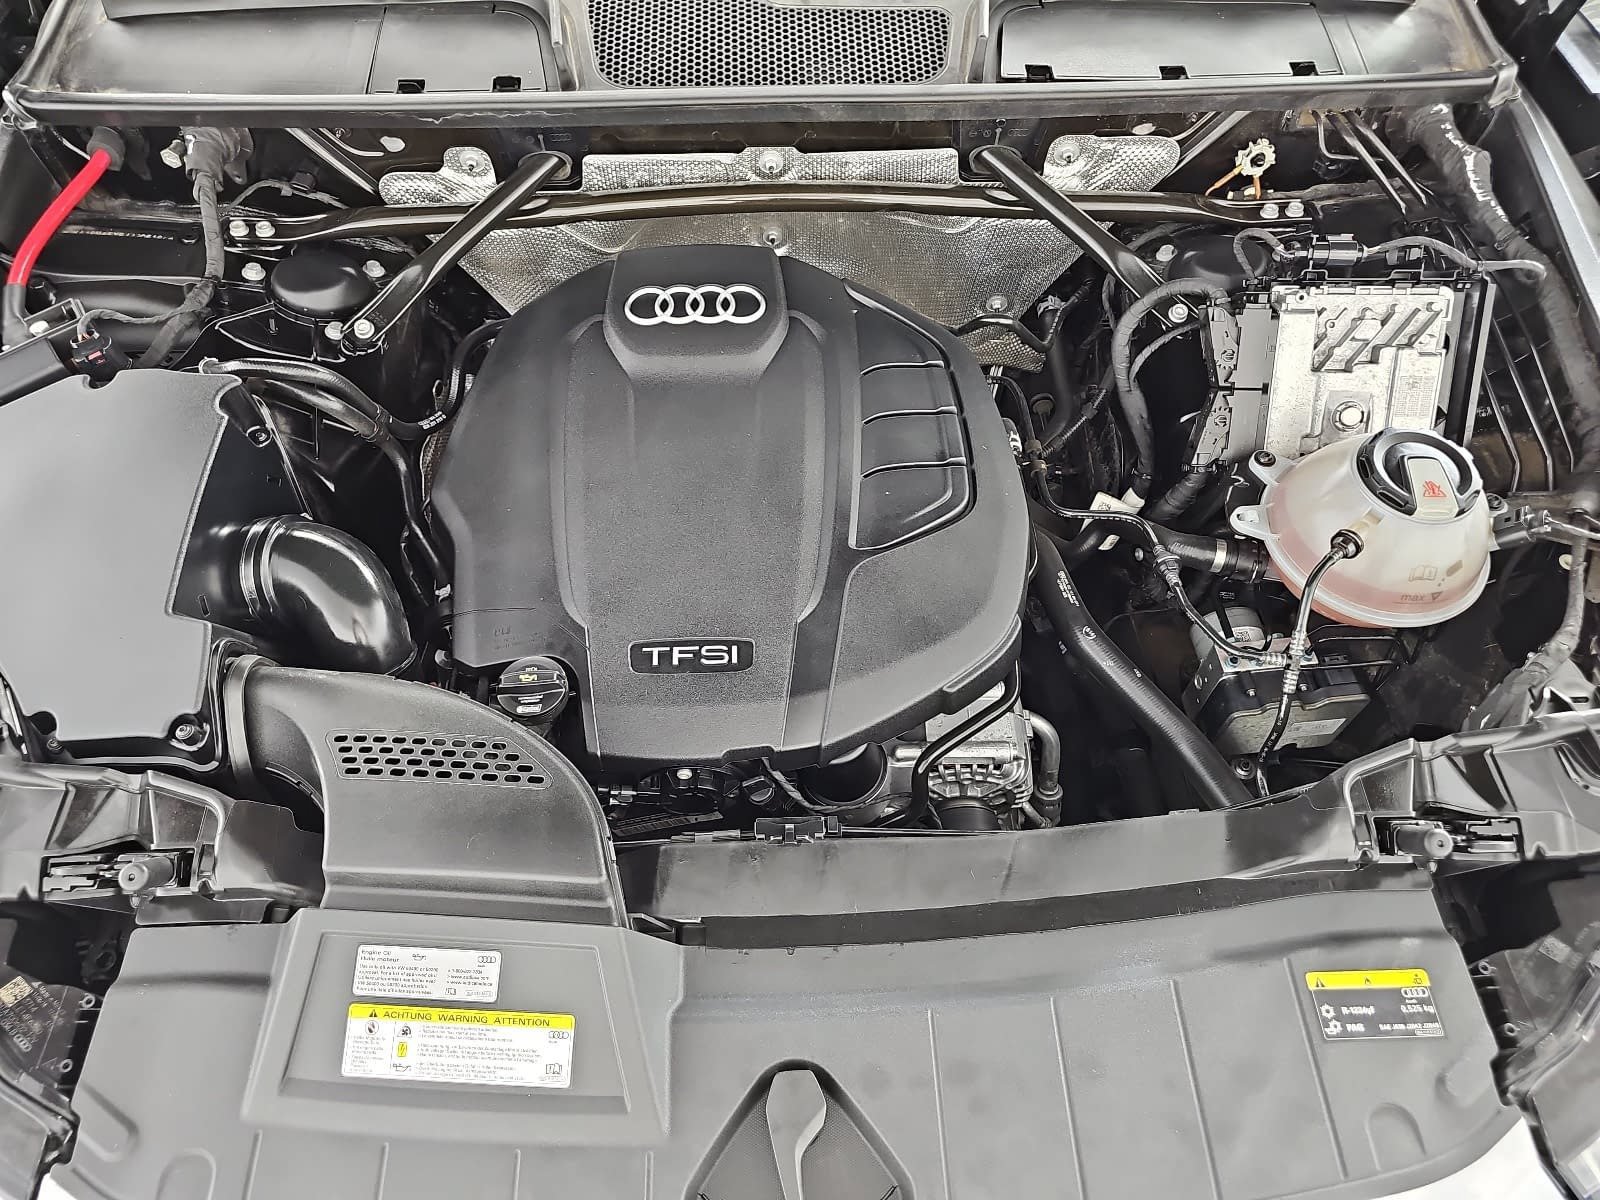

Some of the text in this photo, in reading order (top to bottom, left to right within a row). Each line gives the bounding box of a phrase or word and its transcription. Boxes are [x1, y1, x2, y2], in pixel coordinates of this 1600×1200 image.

[1400, 593, 1425, 601] max
[642, 645, 738, 666] TFSI
[383, 1010, 551, 1027] ACHTUNG WARNING ATTENTION
